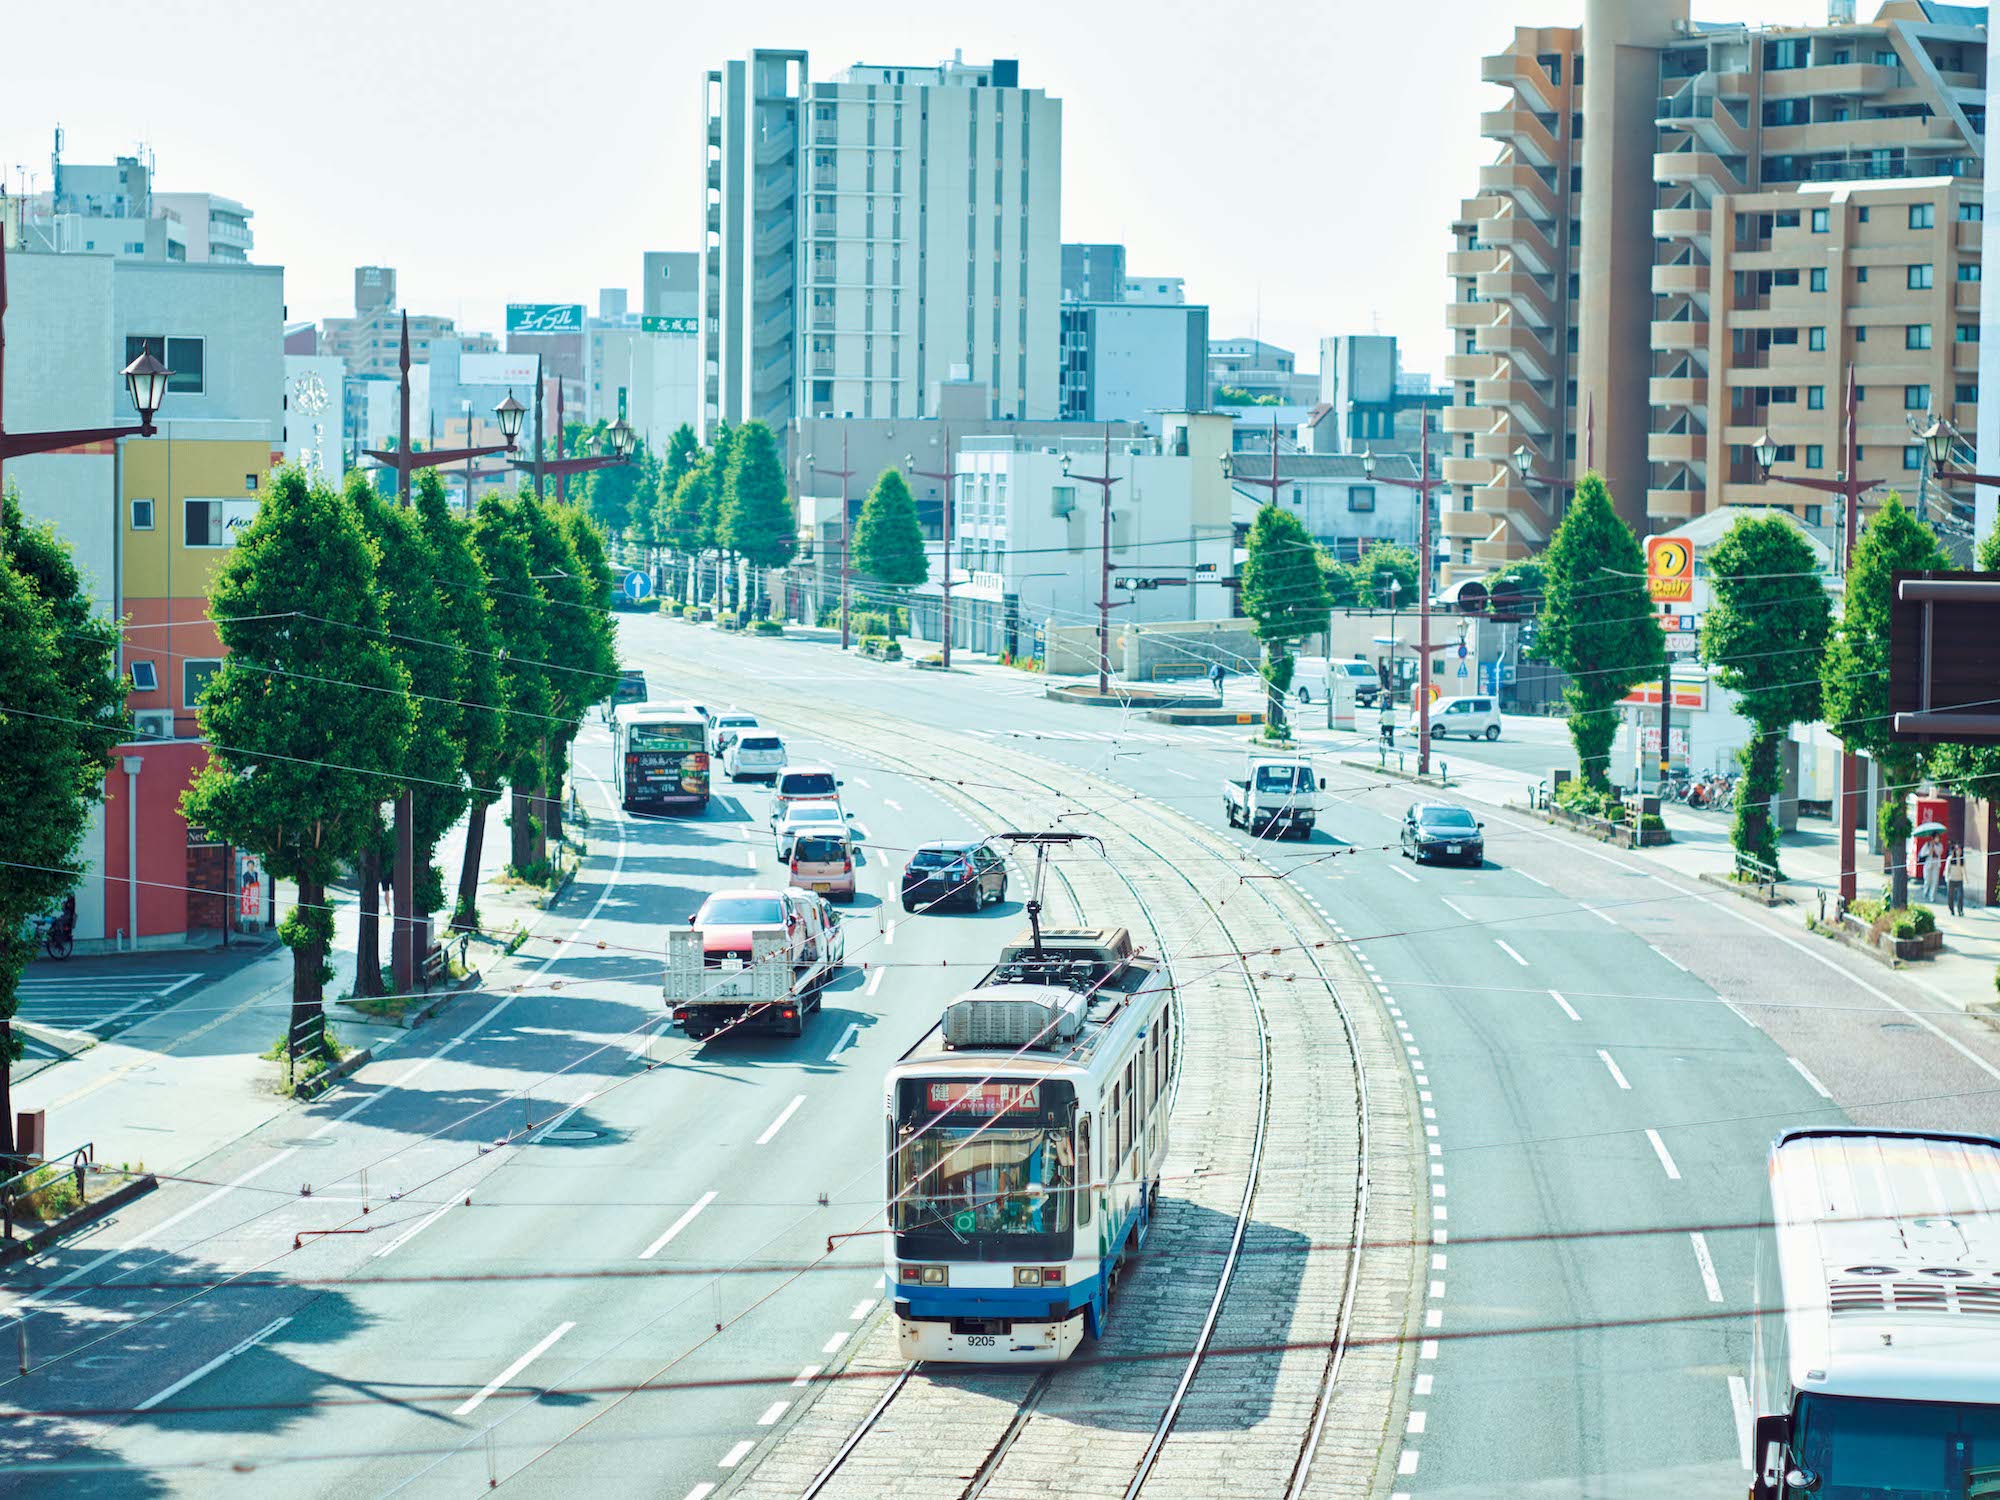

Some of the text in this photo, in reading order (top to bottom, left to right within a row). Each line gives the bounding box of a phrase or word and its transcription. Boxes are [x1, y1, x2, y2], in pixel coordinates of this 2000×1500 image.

[514, 307, 574, 330] エイブル
[1652, 579, 1691, 598] Daily
[931, 1083, 1018, 1103] 健軍町
[968, 1335, 995, 1346] 9205
